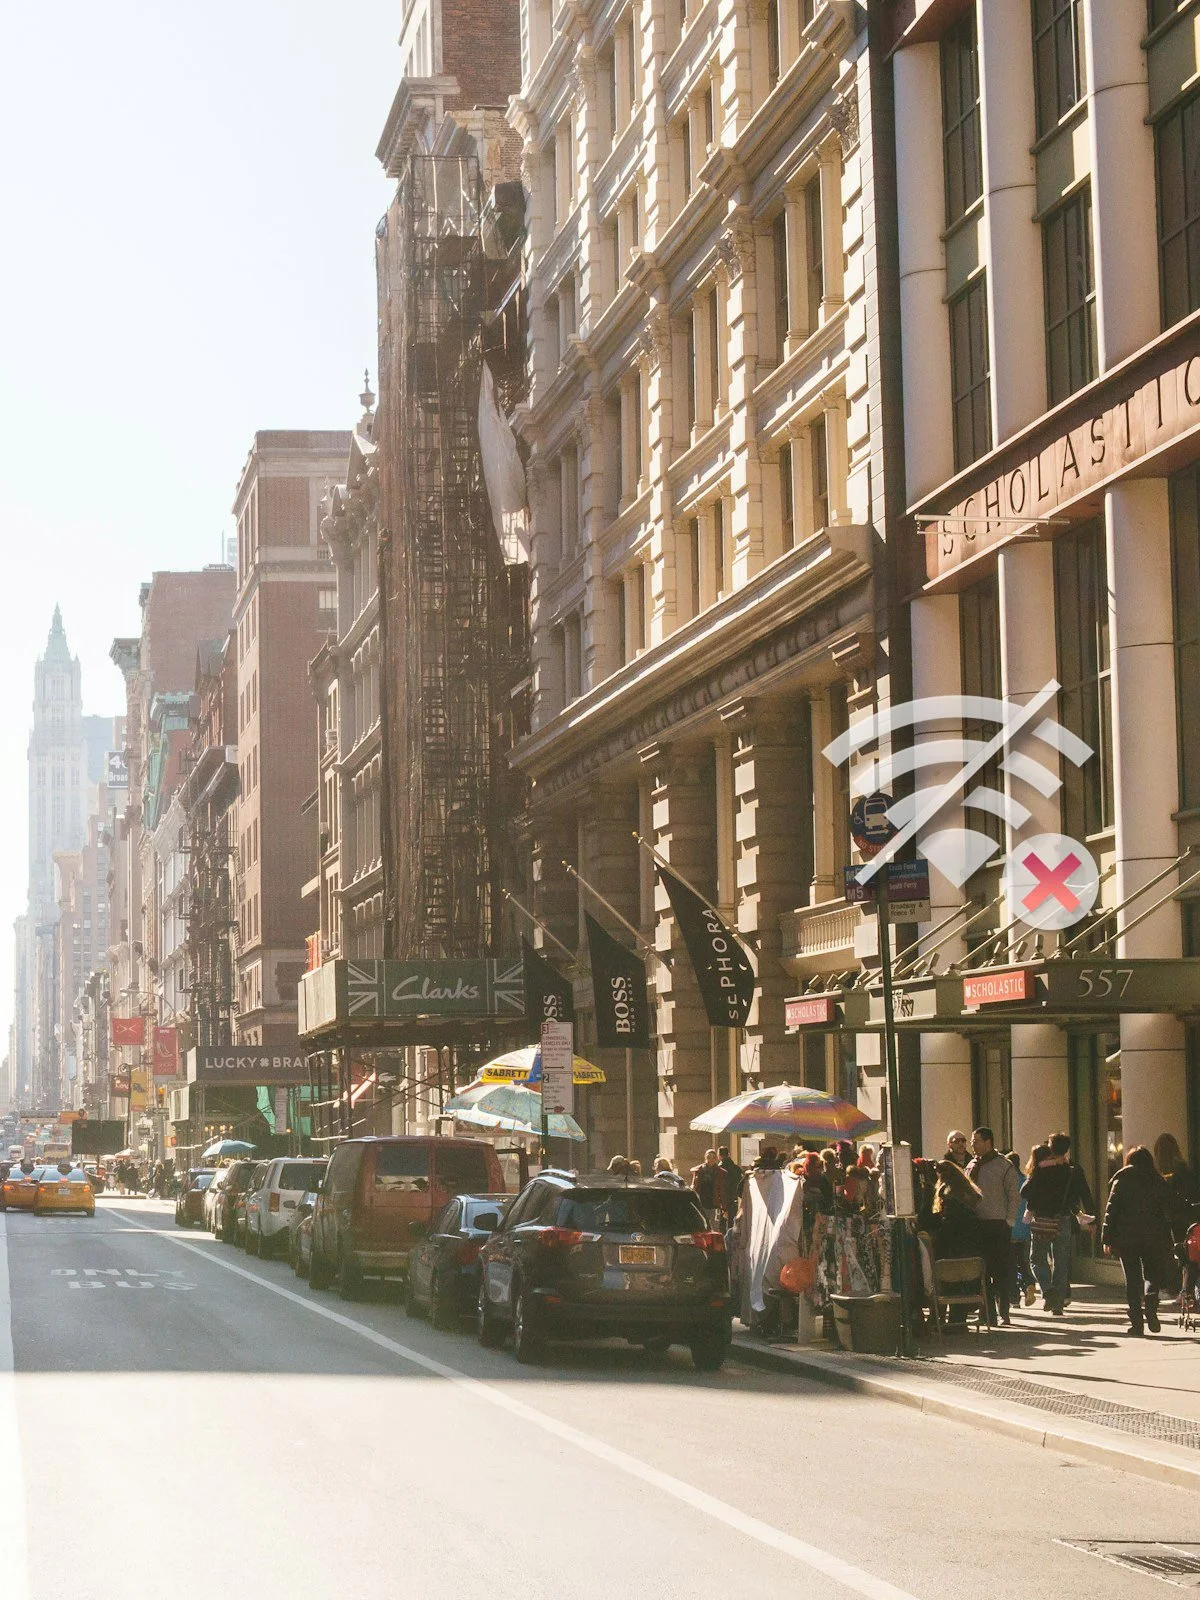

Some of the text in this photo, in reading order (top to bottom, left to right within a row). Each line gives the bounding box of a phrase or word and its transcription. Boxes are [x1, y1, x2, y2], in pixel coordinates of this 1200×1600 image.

[847, 887, 864, 900] M5
[702, 909, 739, 1020] SEPHORA
[392, 974, 480, 1001] Clarks
[971, 977, 1024, 999] SCHOLASTIC
[1077, 969, 1134, 998] 557
[611, 976, 631, 1034] BOSS
[791, 1003, 827, 1019] SCHOLASTIC
[205, 1057, 258, 1069] LUCKY
[486, 1067, 529, 1081] SABRETT
[50, 1268, 185, 1278] ONLY
[68, 1281, 198, 1291] BUS
